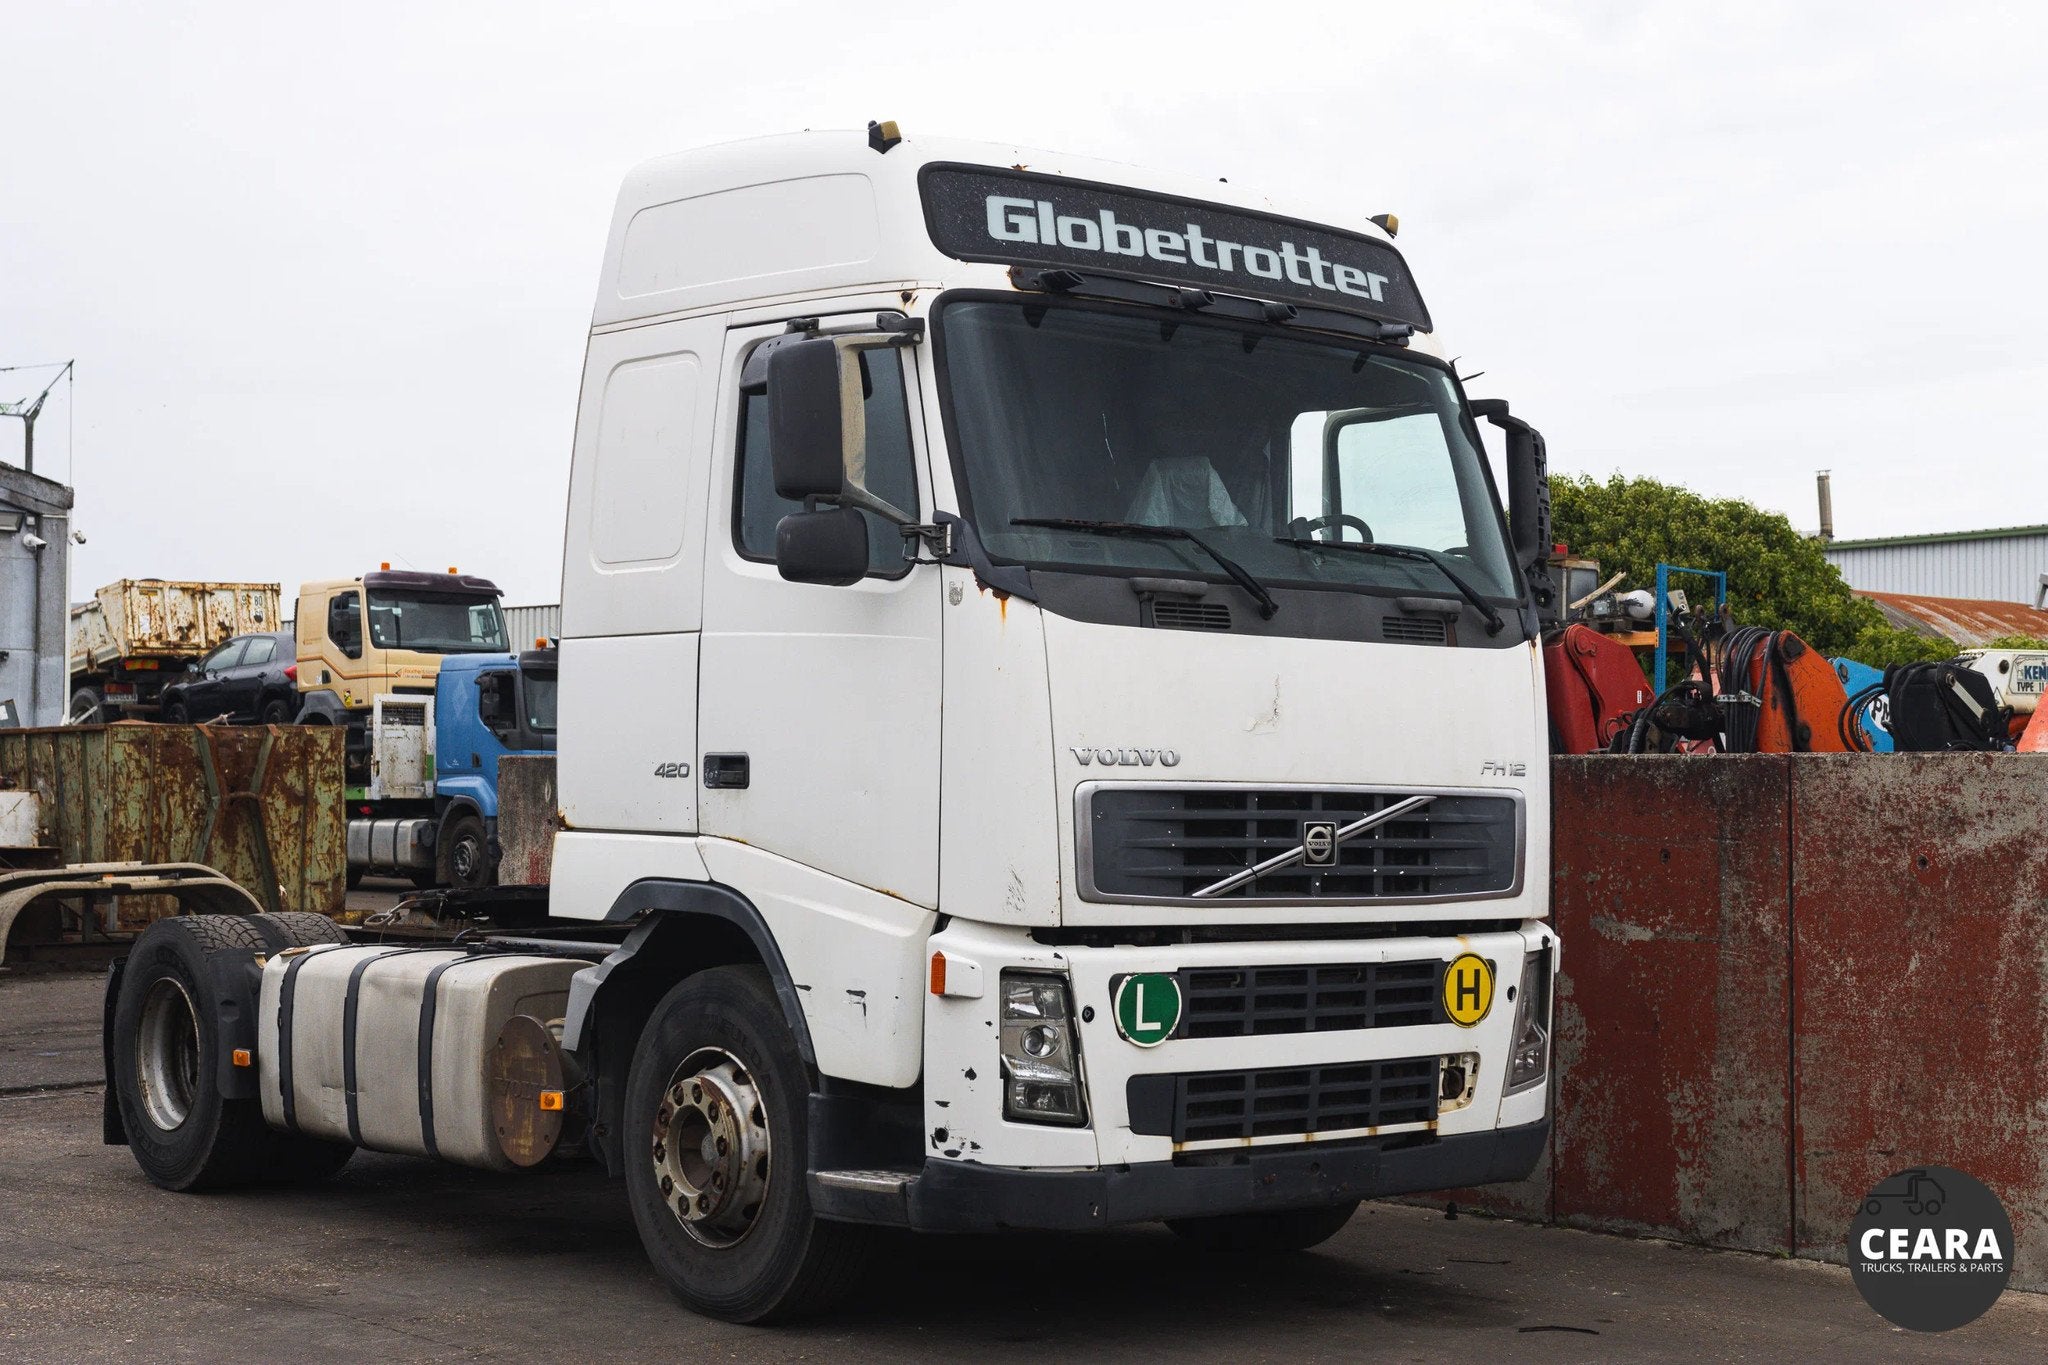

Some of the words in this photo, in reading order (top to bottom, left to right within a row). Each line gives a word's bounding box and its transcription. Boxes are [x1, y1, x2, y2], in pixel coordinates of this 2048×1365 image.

[986, 195, 1388, 302] Globetrotter
[2024, 665, 2048, 680] KEN
[2017, 681, 2034, 692] TYPE
[1069, 747, 1181, 767] VOLVO
[654, 763, 690, 778] 420
[1456, 968, 1481, 1011] H
[1136, 983, 1162, 1031] L
